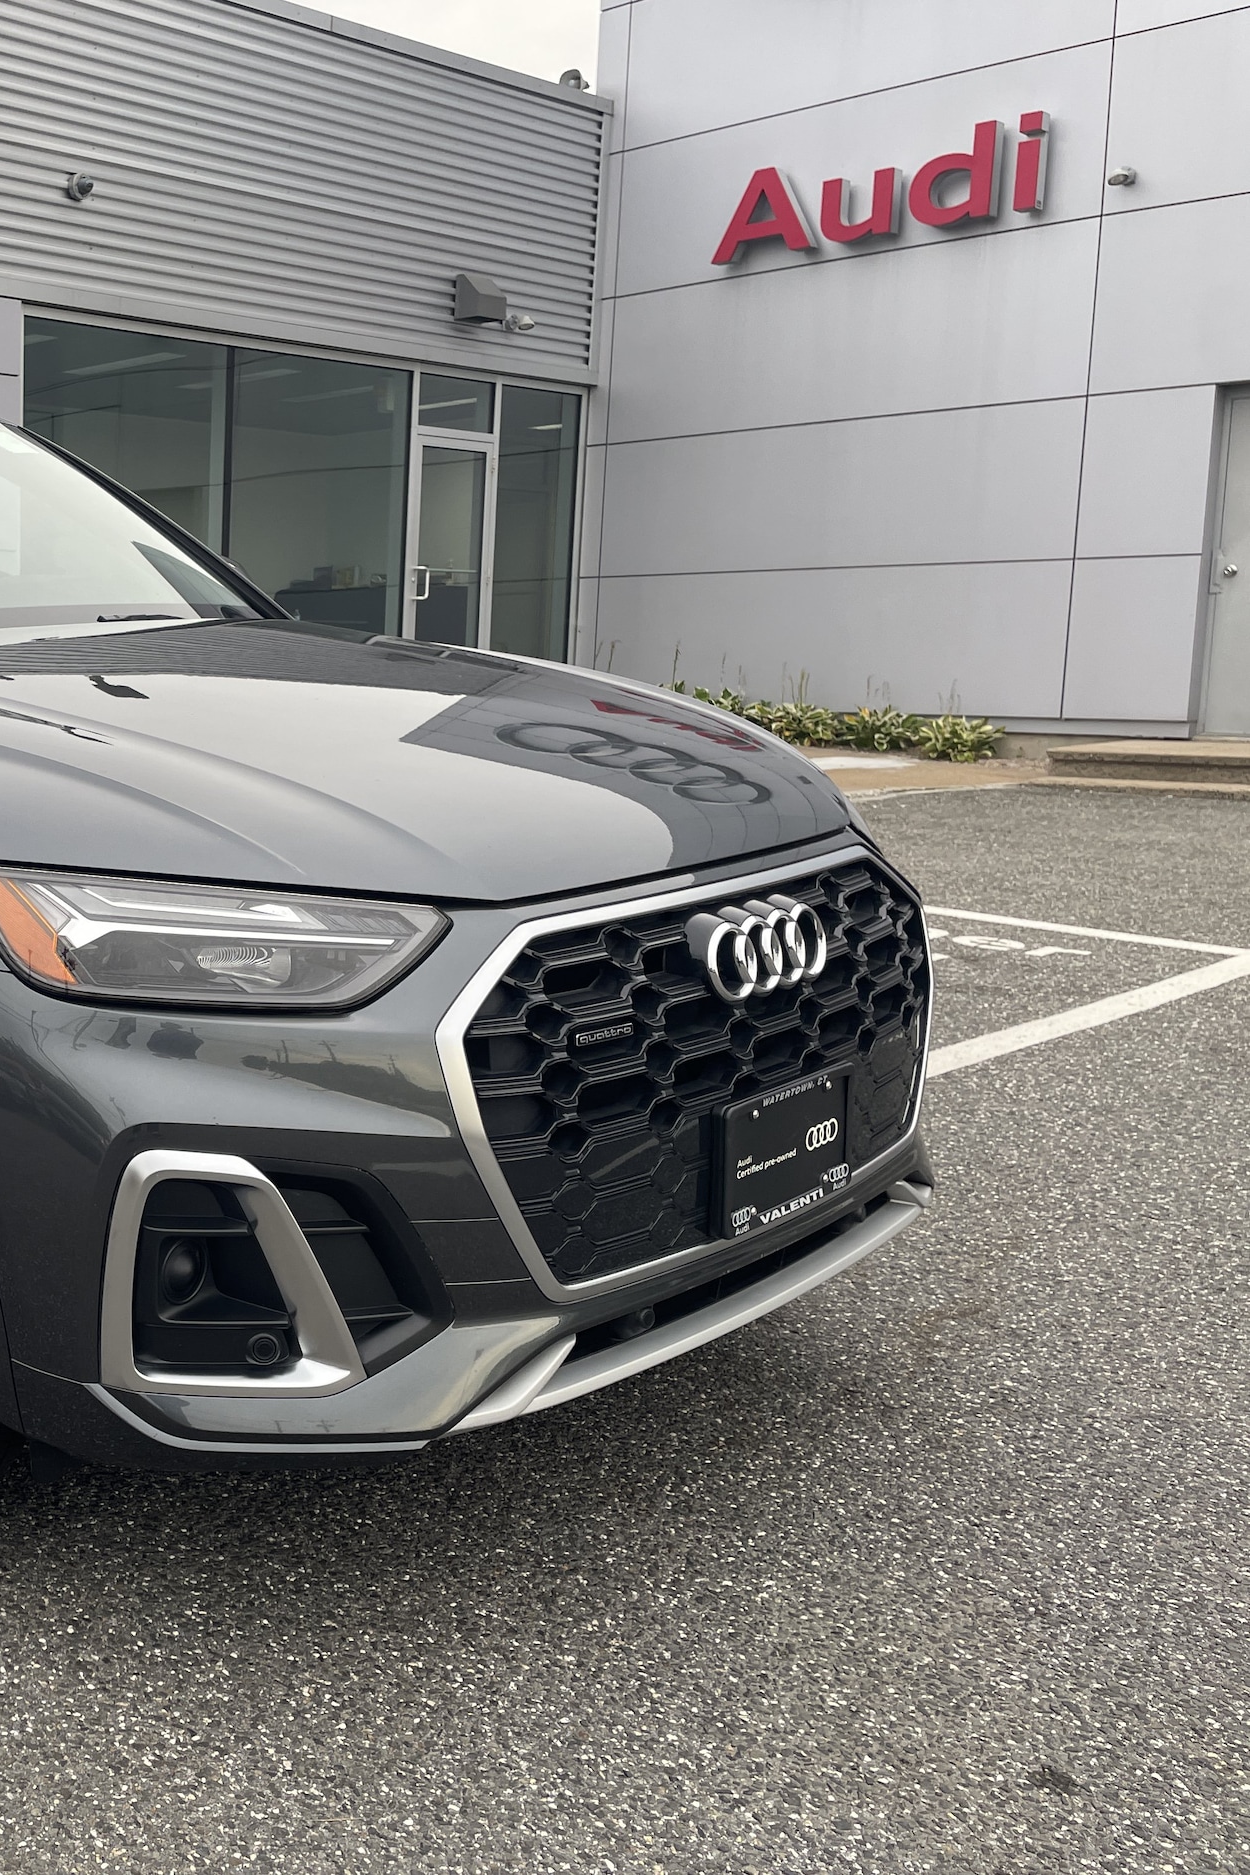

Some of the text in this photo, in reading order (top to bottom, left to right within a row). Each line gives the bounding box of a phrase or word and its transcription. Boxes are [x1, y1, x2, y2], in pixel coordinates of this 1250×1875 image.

[711, 110, 1047, 265] Audi
[579, 1026, 632, 1044] quattro
[762, 1075, 828, 1107] WATERTOWN, CT
[736, 1155, 753, 1168] Audi
[736, 1148, 797, 1180] Certified pre-owned
[832, 1178, 847, 1191] Audi
[759, 1187, 824, 1225] VALENTI
[734, 1224, 750, 1237] Audi
